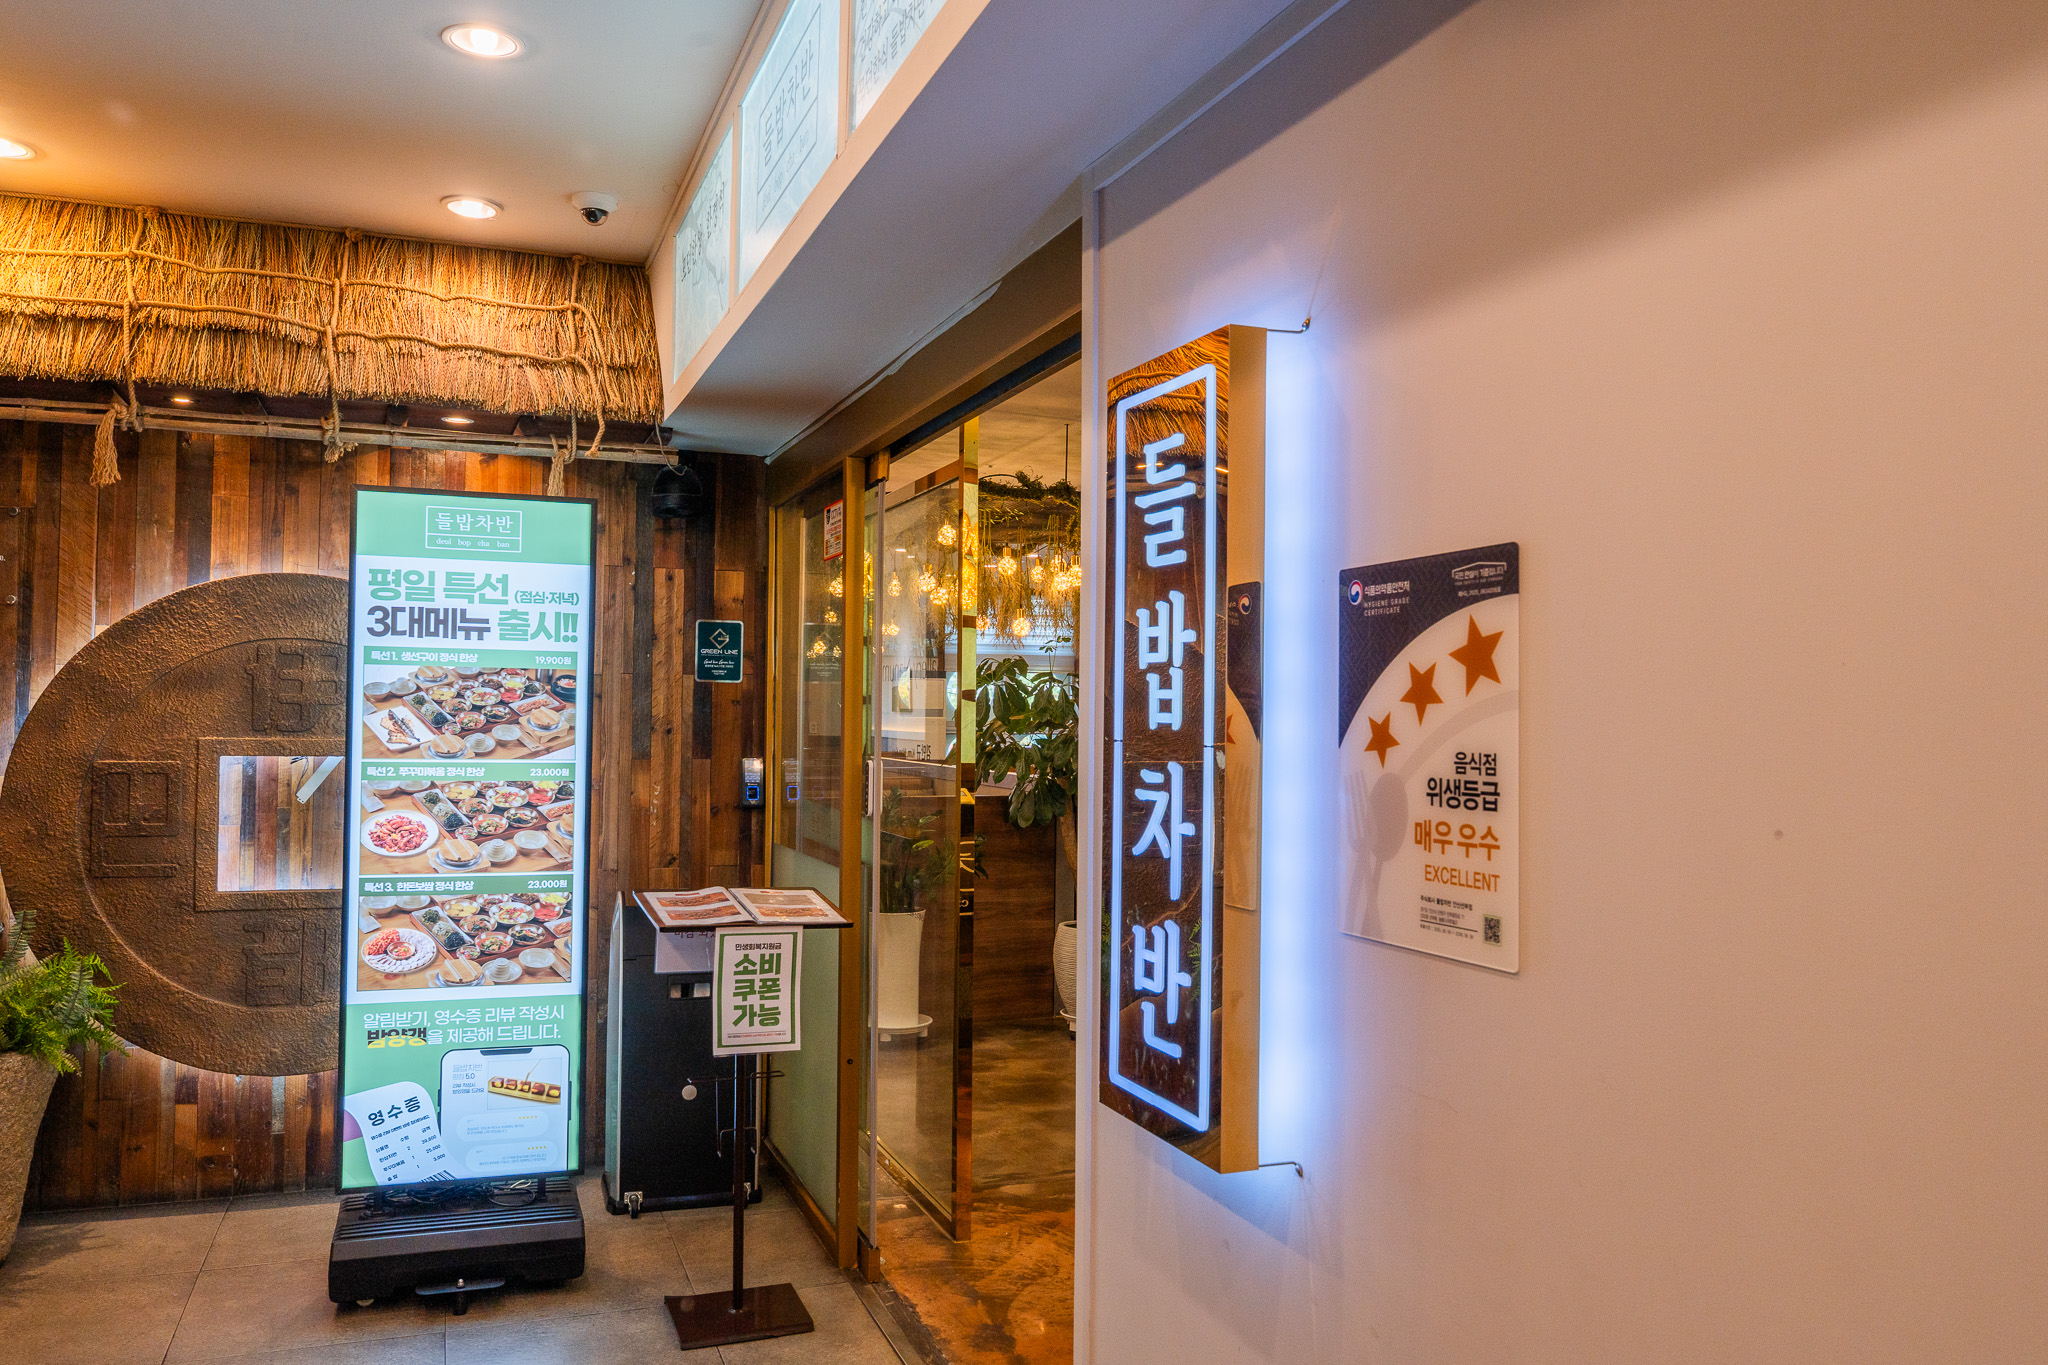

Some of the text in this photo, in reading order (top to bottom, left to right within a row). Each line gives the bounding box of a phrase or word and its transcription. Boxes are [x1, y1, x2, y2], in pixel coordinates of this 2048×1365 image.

[763, 39, 814, 167] 들밥차반
[435, 512, 514, 533] 들밥차반
[458, 539, 471, 548] bop
[368, 568, 435, 603] 평일
[443, 571, 509, 605] 특선
[1363, 597, 1410, 608] HYGIENE GRADE
[1363, 606, 1400, 616] CERTIFICATE
[366, 606, 579, 643] 3대메뉴 출시!!
[401, 651, 438, 662] 생선구이
[439, 652, 458, 662] 정식
[459, 653, 478, 663] 한상
[535, 656, 571, 665] 19,900원
[1131, 432, 1197, 1059] 들밥차반
[446, 767, 465, 777] 정식
[466, 767, 485, 777] 한상
[530, 768, 570, 777] 23,000원
[1454, 751, 1497, 776] 음식점
[1426, 777, 1500, 812] 위생등급
[1414, 819, 1501, 861] 매우 우수
[396, 881, 434, 892] 한돈보쌈
[435, 881, 454, 891] 정식
[455, 880, 474, 891] 한상
[528, 880, 568, 889] 23,000원
[1424, 864, 1500, 892] EXCELLENT
[735, 943, 782, 951] 민생회복지원금
[733, 953, 782, 976] 소비
[733, 977, 782, 1002] 쿠폰
[363, 1005, 564, 1029] 알림받기, 영수증 리뷰 작성시
[732, 1003, 782, 1027] 가능
[367, 1024, 561, 1048] 밤양갱을 제공해 드립니다.
[368, 1096, 421, 1126] 영수증
